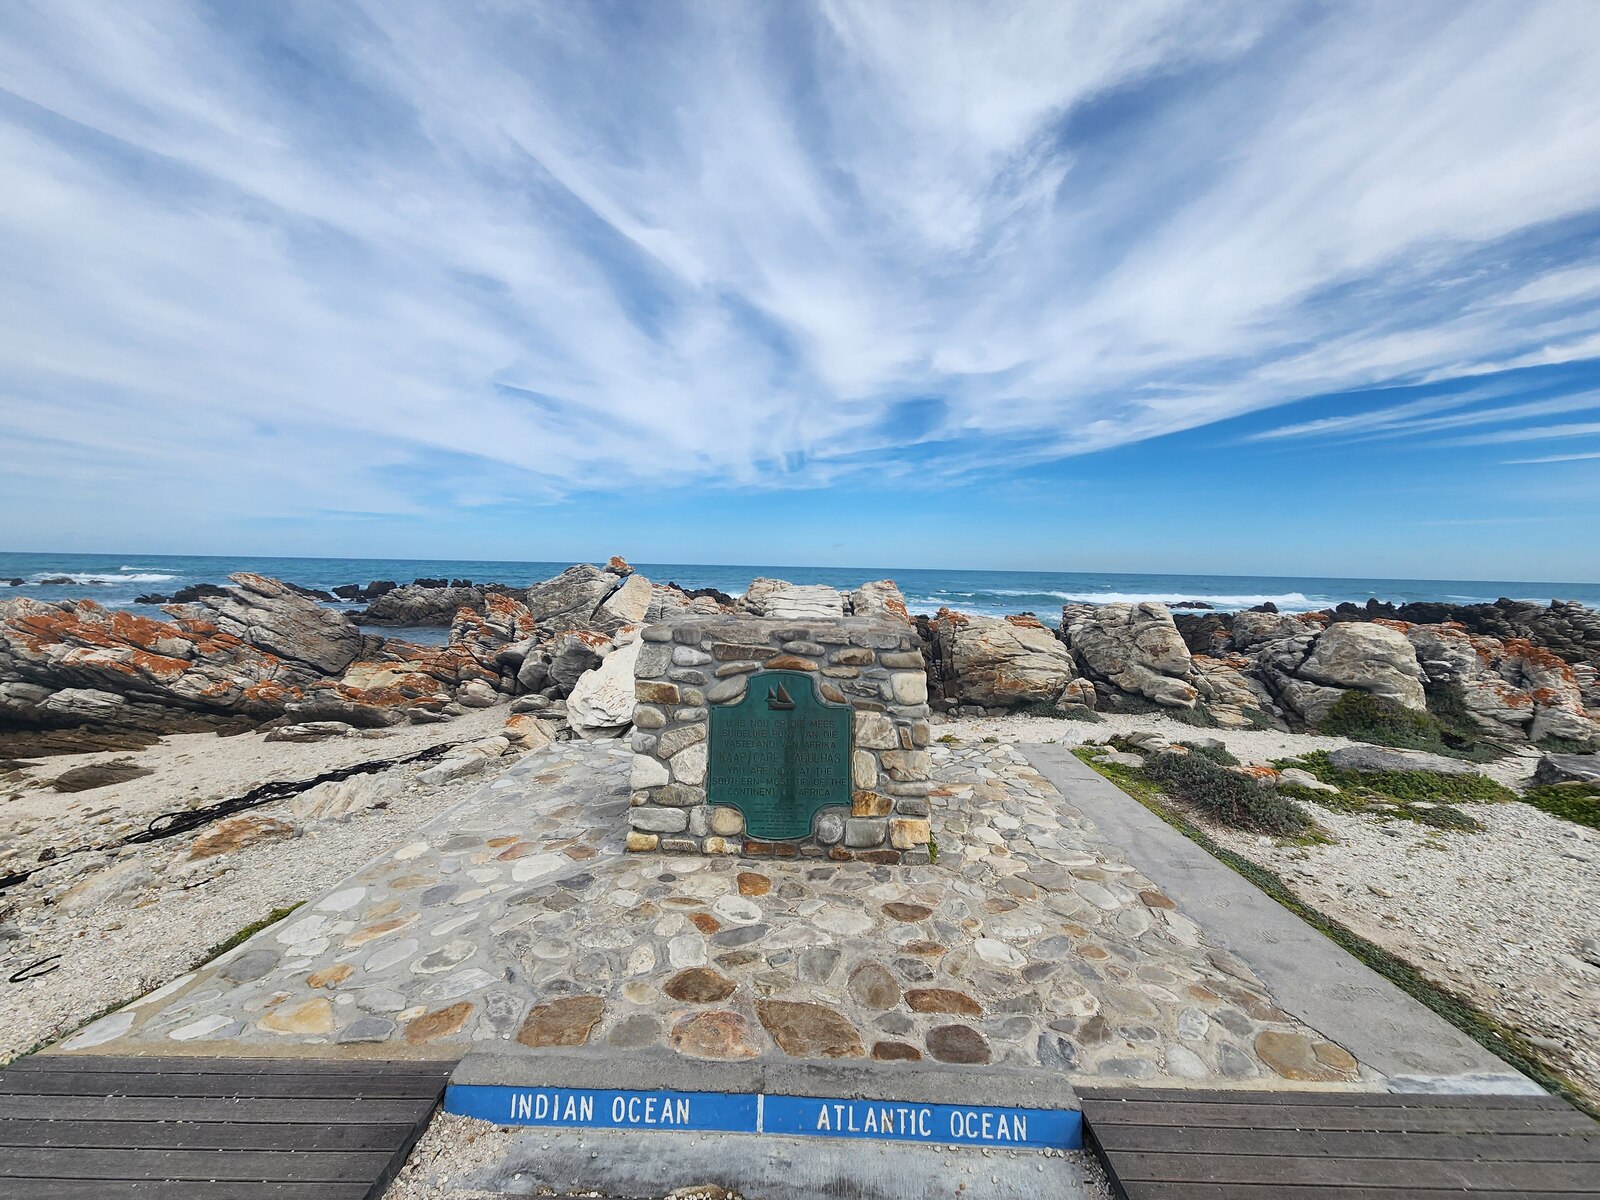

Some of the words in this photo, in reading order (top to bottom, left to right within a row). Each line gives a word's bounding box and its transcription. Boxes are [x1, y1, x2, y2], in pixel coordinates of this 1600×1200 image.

[811, 720, 836, 729] MEES
[722, 729, 768, 738] SUIDELIKE
[823, 730, 838, 739] DIE
[725, 739, 776, 749] VASTELAND
[781, 740, 799, 749] VAN
[803, 741, 837, 750] AFRIKA
[727, 766, 746, 775] YOU
[750, 766, 769, 775] ARE
[800, 767, 811, 775] AT
[816, 767, 833, 775] THE
[795, 777, 809, 786] TIP
[813, 778, 826, 787] OF
[830, 778, 848, 787] THE
[727, 787, 776, 796] CONTINENT
[799, 788, 832, 797] AFRICA
[510, 1093, 594, 1122] INDIAN
[611, 1095, 691, 1125] OCEAN
[816, 1104, 931, 1137] ATLANTIC
[950, 1110, 1028, 1142] OCEAN
